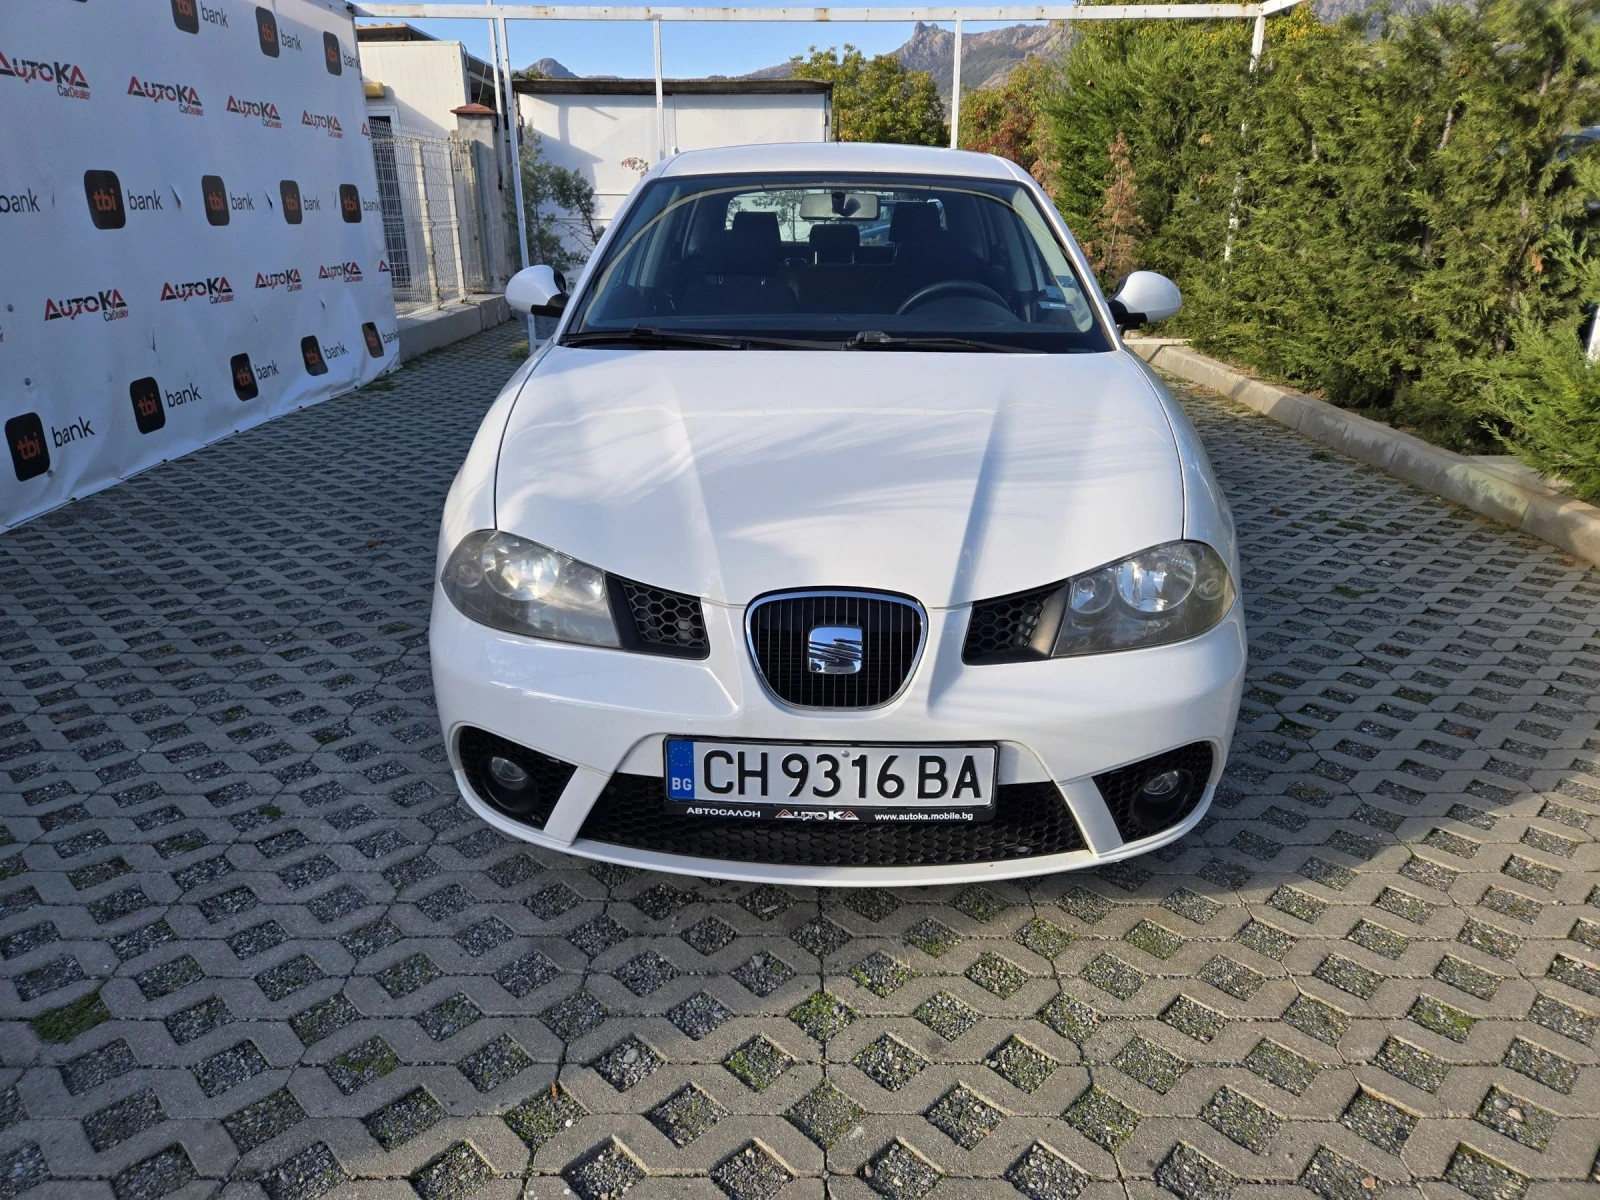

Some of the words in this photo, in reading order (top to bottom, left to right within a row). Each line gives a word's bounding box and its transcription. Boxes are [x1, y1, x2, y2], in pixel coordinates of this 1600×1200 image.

[201, 4, 229, 28] bank
[280, 29, 302, 51] bank
[93, 188, 117, 211] tbi
[127, 189, 163, 211] bank
[230, 192, 254, 211] bank
[303, 194, 320, 211] bank
[324, 341, 349, 360] bank
[255, 360, 280, 380] bank
[138, 393, 158, 417] tbi
[165, 383, 202, 408] bank
[17, 432, 41, 461] tbi
[52, 416, 95, 449] bank
[671, 777, 692, 791] BG
[703, 750, 768, 797] CH
[781, 753, 905, 800] 9316
[917, 754, 982, 799] BA
[686, 806, 761, 819] АВТОСАЛОН
[874, 812, 974, 822] www.autoka.mobile.bg
